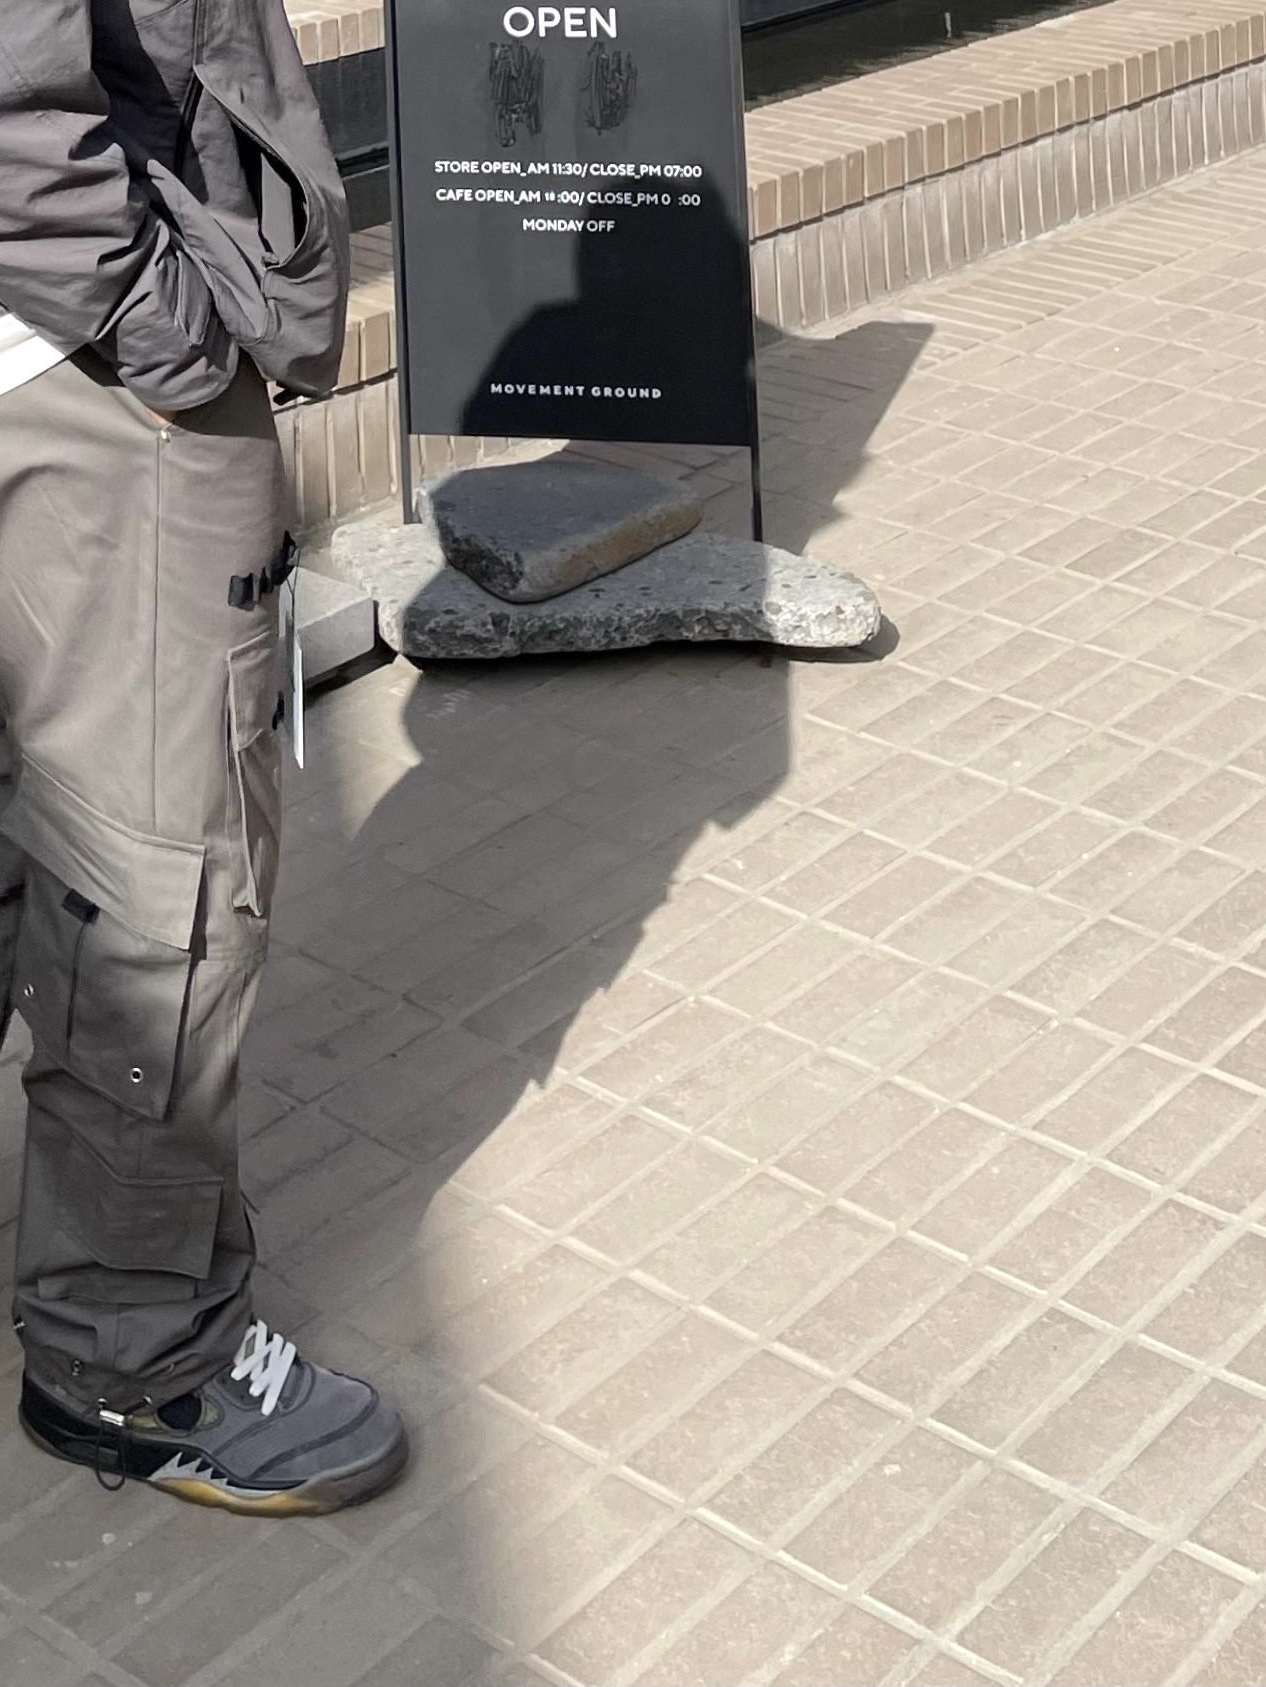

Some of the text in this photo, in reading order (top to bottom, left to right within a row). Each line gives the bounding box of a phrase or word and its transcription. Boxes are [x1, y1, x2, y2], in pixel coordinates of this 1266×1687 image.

[502, 6, 618, 39] OPEN
[434, 160, 479, 174] STORE
[481, 161, 549, 176] OPEN_AM
[590, 162, 661, 179] CLOSE_PM
[663, 164, 702, 178] 07:00
[435, 188, 473, 202] CAFE
[474, 189, 541, 205] OPEN_AM
[586, 191, 659, 208] CLOSE_PM
[522, 218, 615, 233] MONDAY OFF
[490, 382, 662, 400] MOVEMENT GROUND
